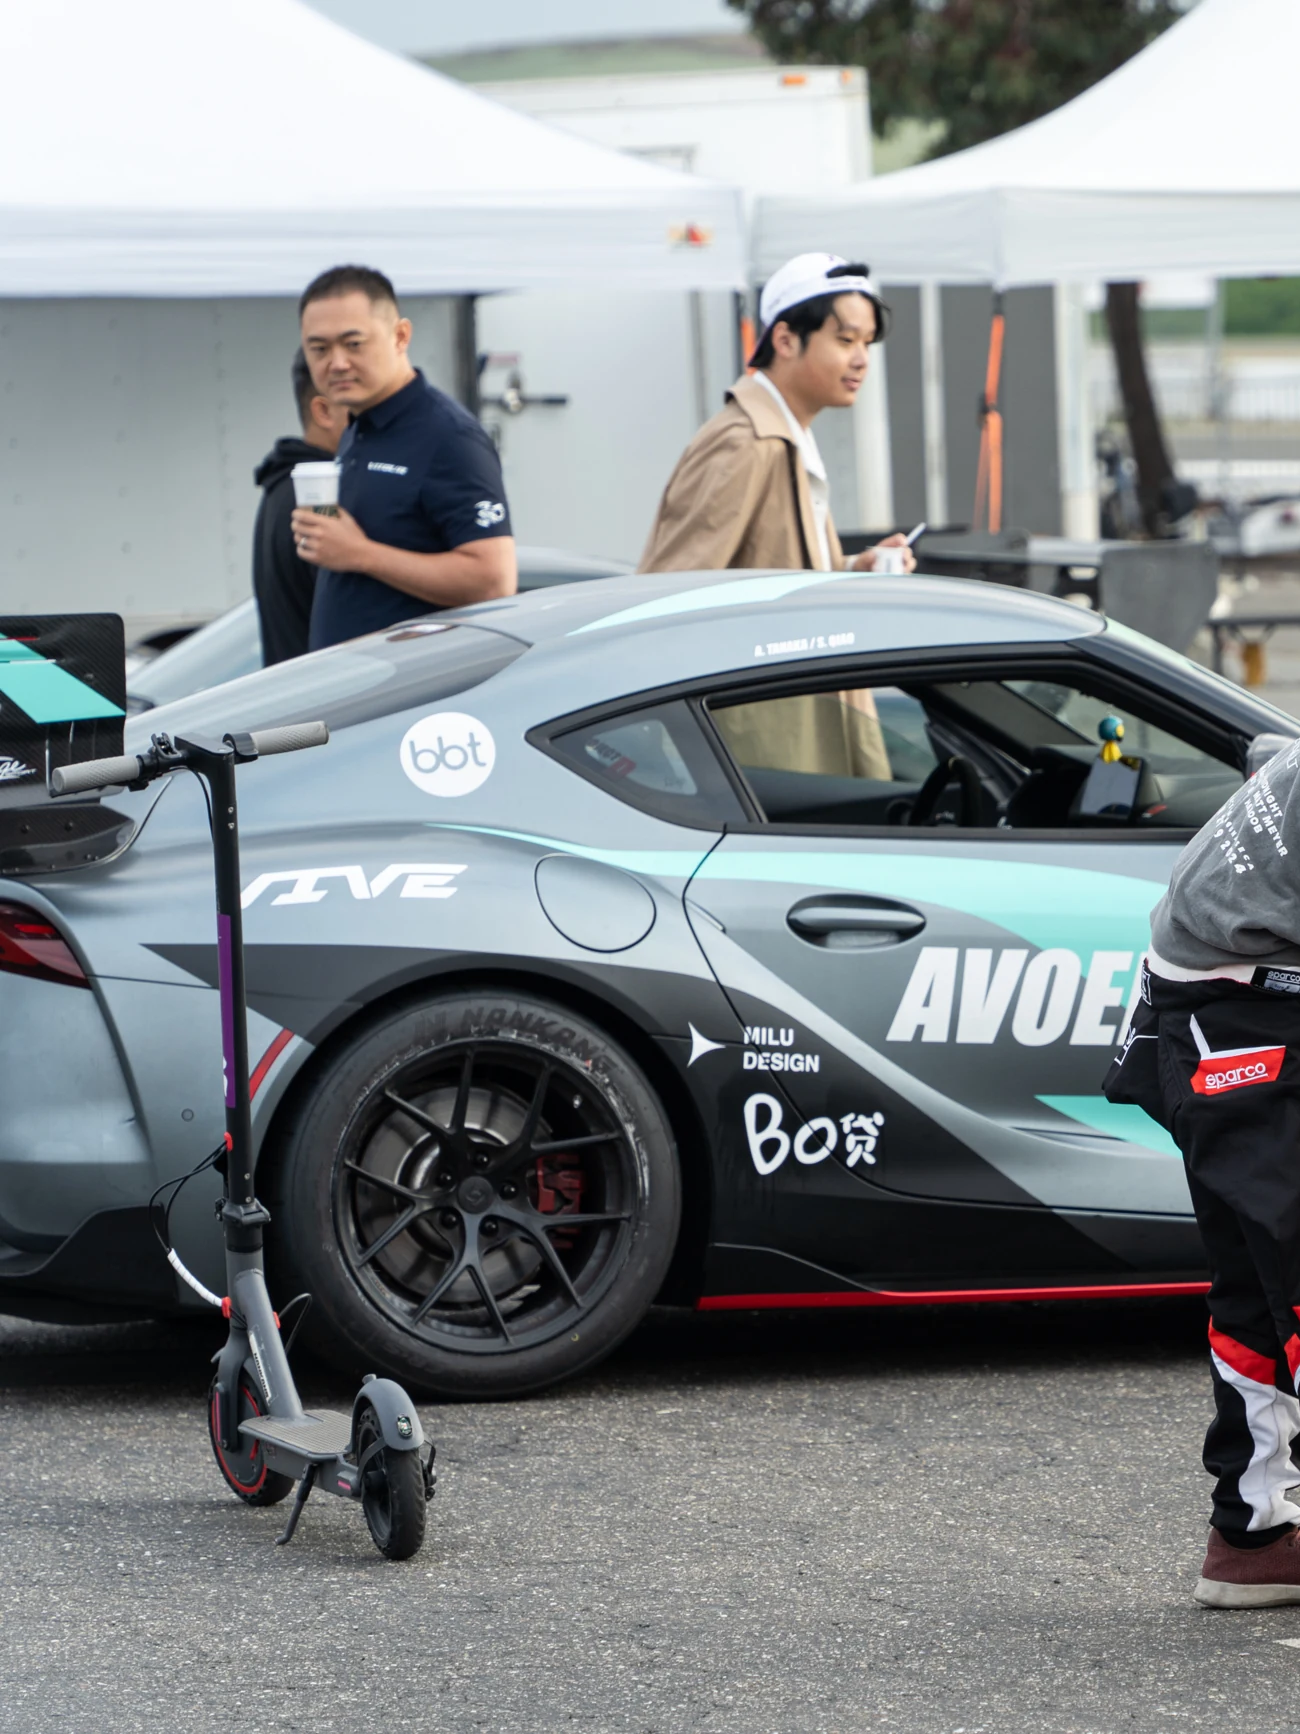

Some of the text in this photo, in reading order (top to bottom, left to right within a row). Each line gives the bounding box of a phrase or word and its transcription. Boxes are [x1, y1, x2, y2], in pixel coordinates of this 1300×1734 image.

[408, 731, 487, 773] bbt
[1263, 815, 1288, 857] MEYER
[1267, 970, 1300, 983] sparco
[886, 946, 1145, 1046] AVOE
[744, 1026, 795, 1047] MILU
[743, 1050, 820, 1073] DESIGN
[1205, 1061, 1267, 1090] sparco
